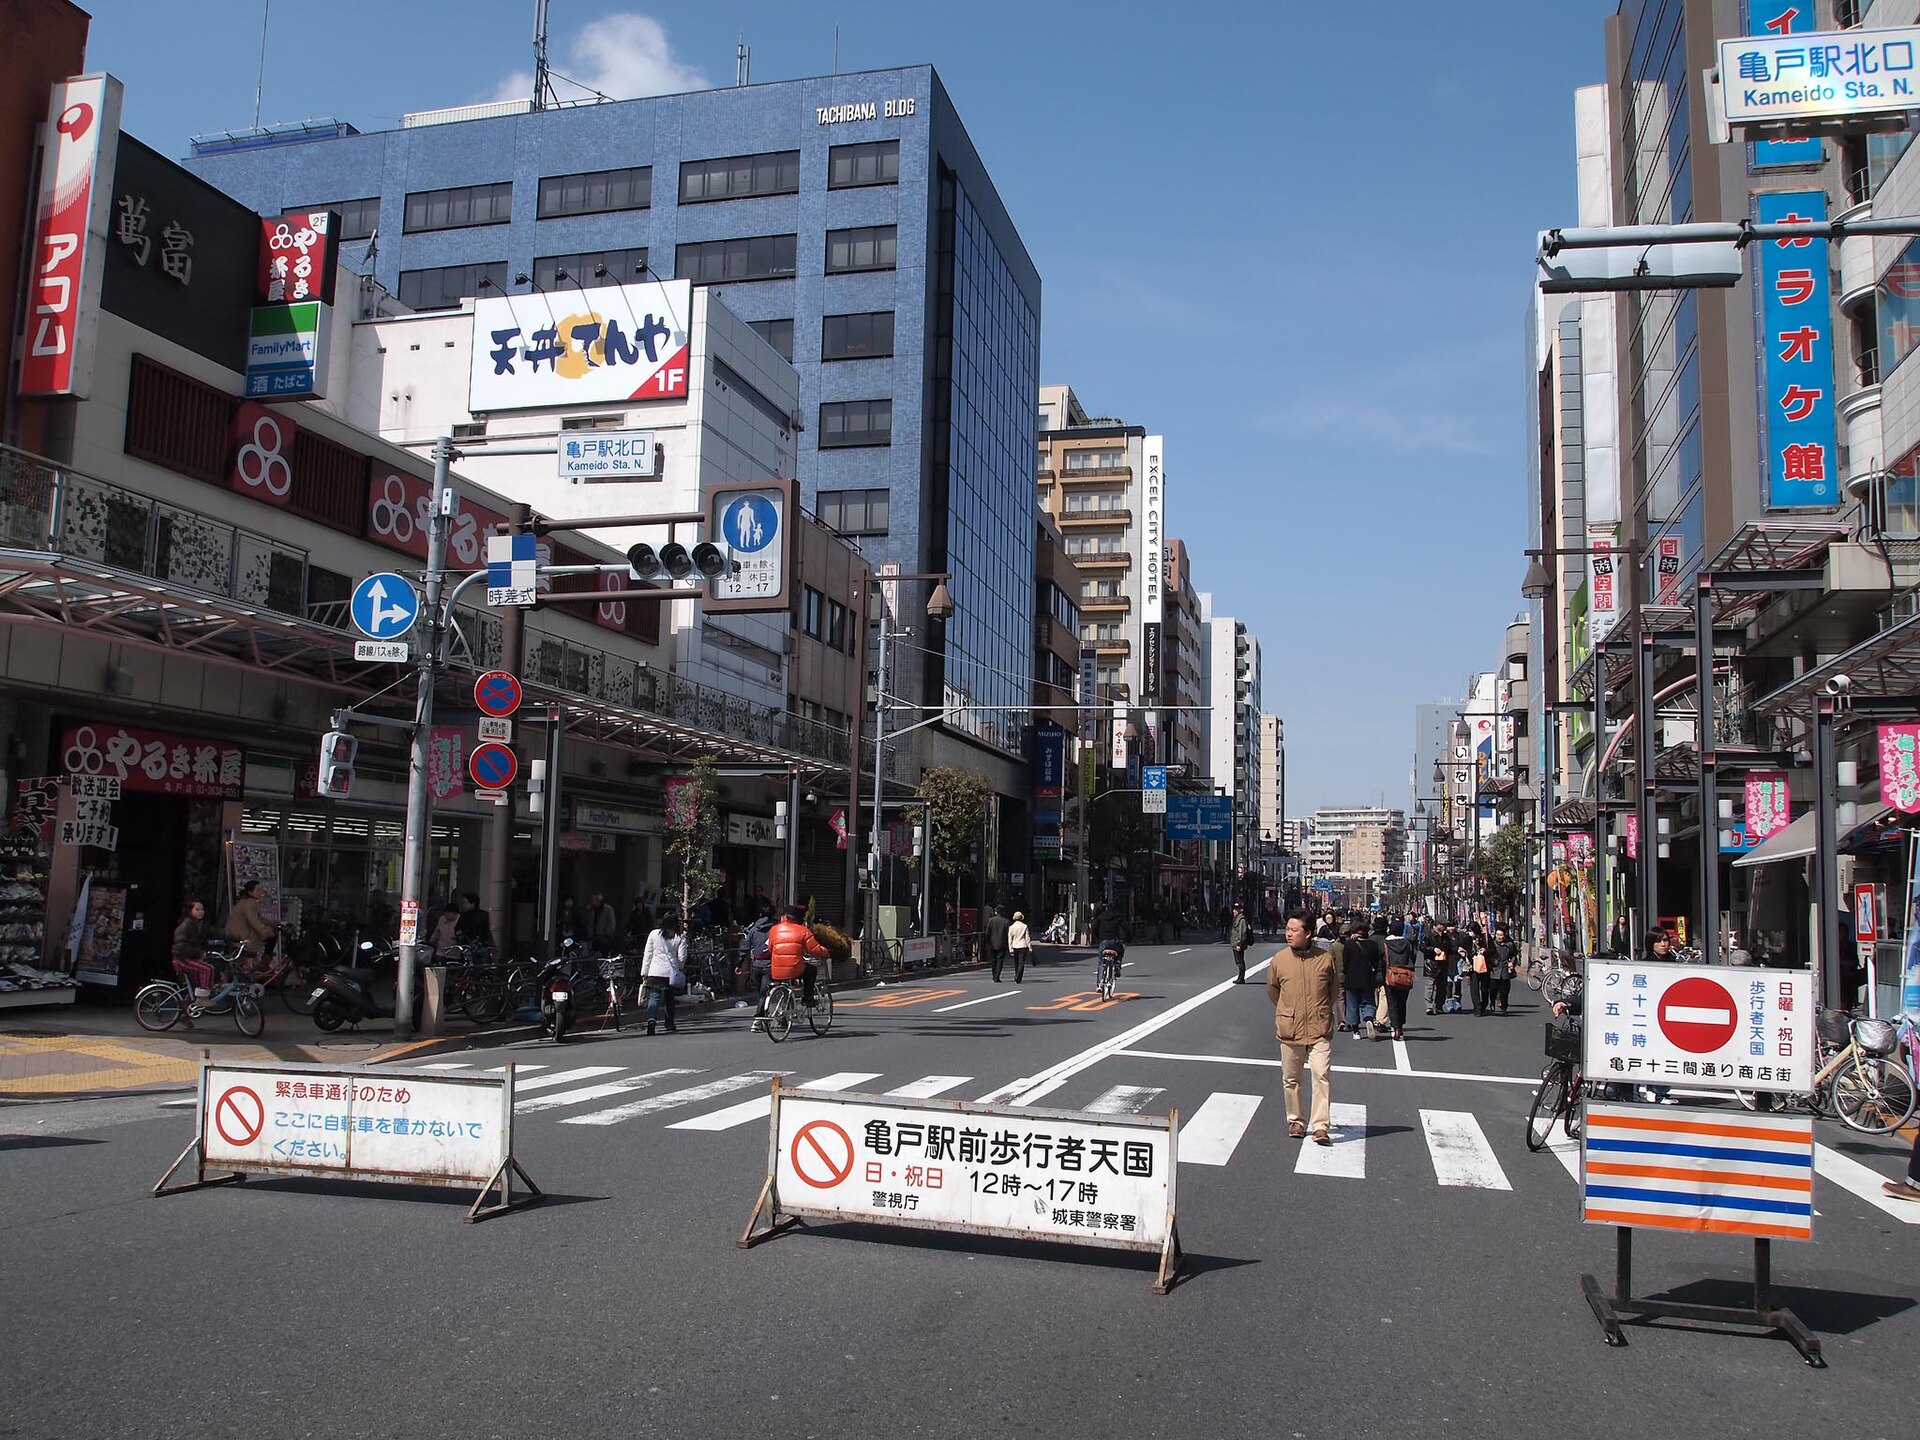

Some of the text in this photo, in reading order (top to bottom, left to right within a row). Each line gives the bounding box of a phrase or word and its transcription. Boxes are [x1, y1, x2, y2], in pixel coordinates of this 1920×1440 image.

[1737, 41, 1913, 83] 亀戸駅北口
[1744, 79, 1913, 106] Kameido Sta. N.
[816, 98, 915, 125] TACHIBANA BLDG
[313, 216, 326, 227] 2F
[293, 228, 317, 299] やるき
[32, 232, 78, 356] アコム
[251, 340, 312, 356] FamilyMart
[490, 313, 671, 375] 天丼てんや
[1775, 213, 1825, 481] カラオケ館
[253, 374, 306, 393] 酒 たばこ
[654, 368, 685, 392] 1F
[566, 439, 646, 458] 亀戸駅北口
[567, 459, 644, 471] Kameido Sta. N.
[1147, 455, 1159, 605] EXCEL CITY HOTEL
[488, 588, 535, 604] 時差式
[728, 584, 741, 593] 12
[756, 583, 769, 592] 17
[358, 645, 406, 658] 路線バスを除く
[106, 729, 243, 786] やるき茶屋
[71, 775, 119, 798] 歓送迎会
[78, 801, 110, 823] ご予約
[63, 822, 114, 847] 承ります!
[1605, 973, 1620, 1046] 夕五時
[1632, 974, 1647, 1047] 昼十二時
[1750, 981, 1766, 1056] 歩行者天国
[1778, 982, 1793, 1057] 日曜・祝日
[1610, 1057, 1791, 1083] 亀戸十三間通り商店街
[276, 1081, 411, 1104] 緊急車通行のため
[274, 1112, 483, 1139] ここに自転車を置かないで
[273, 1139, 347, 1160] ください。
[863, 1119, 1153, 1178] 亀戸駅前歩行者天国
[866, 1162, 943, 1189] 日・祝日
[872, 1191, 919, 1210] 警視庁
[1051, 1207, 1136, 1231] 城東警察署
